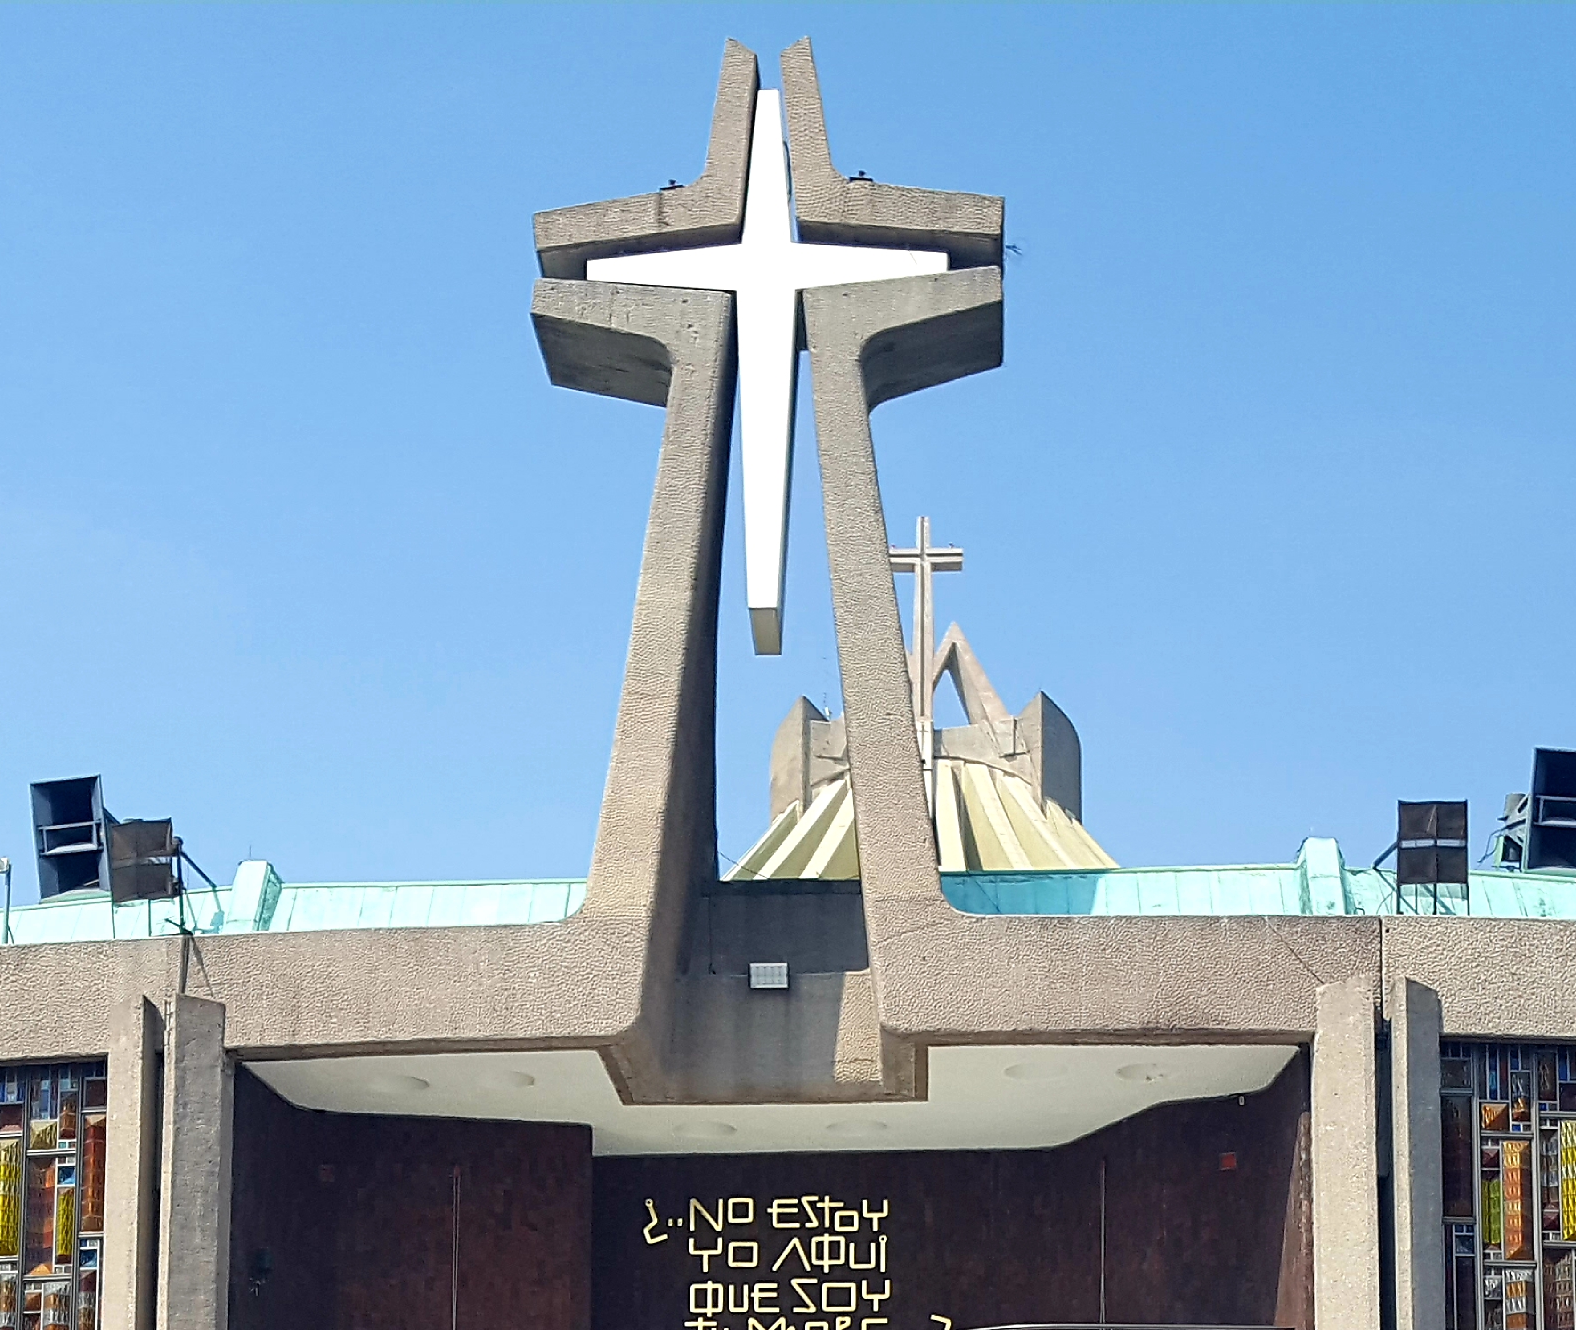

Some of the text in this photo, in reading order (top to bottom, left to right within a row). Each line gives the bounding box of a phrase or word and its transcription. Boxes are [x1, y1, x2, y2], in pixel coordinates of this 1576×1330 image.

[688, 1237, 758, 1273] YO
[689, 1278, 891, 1317] QUE SOY
